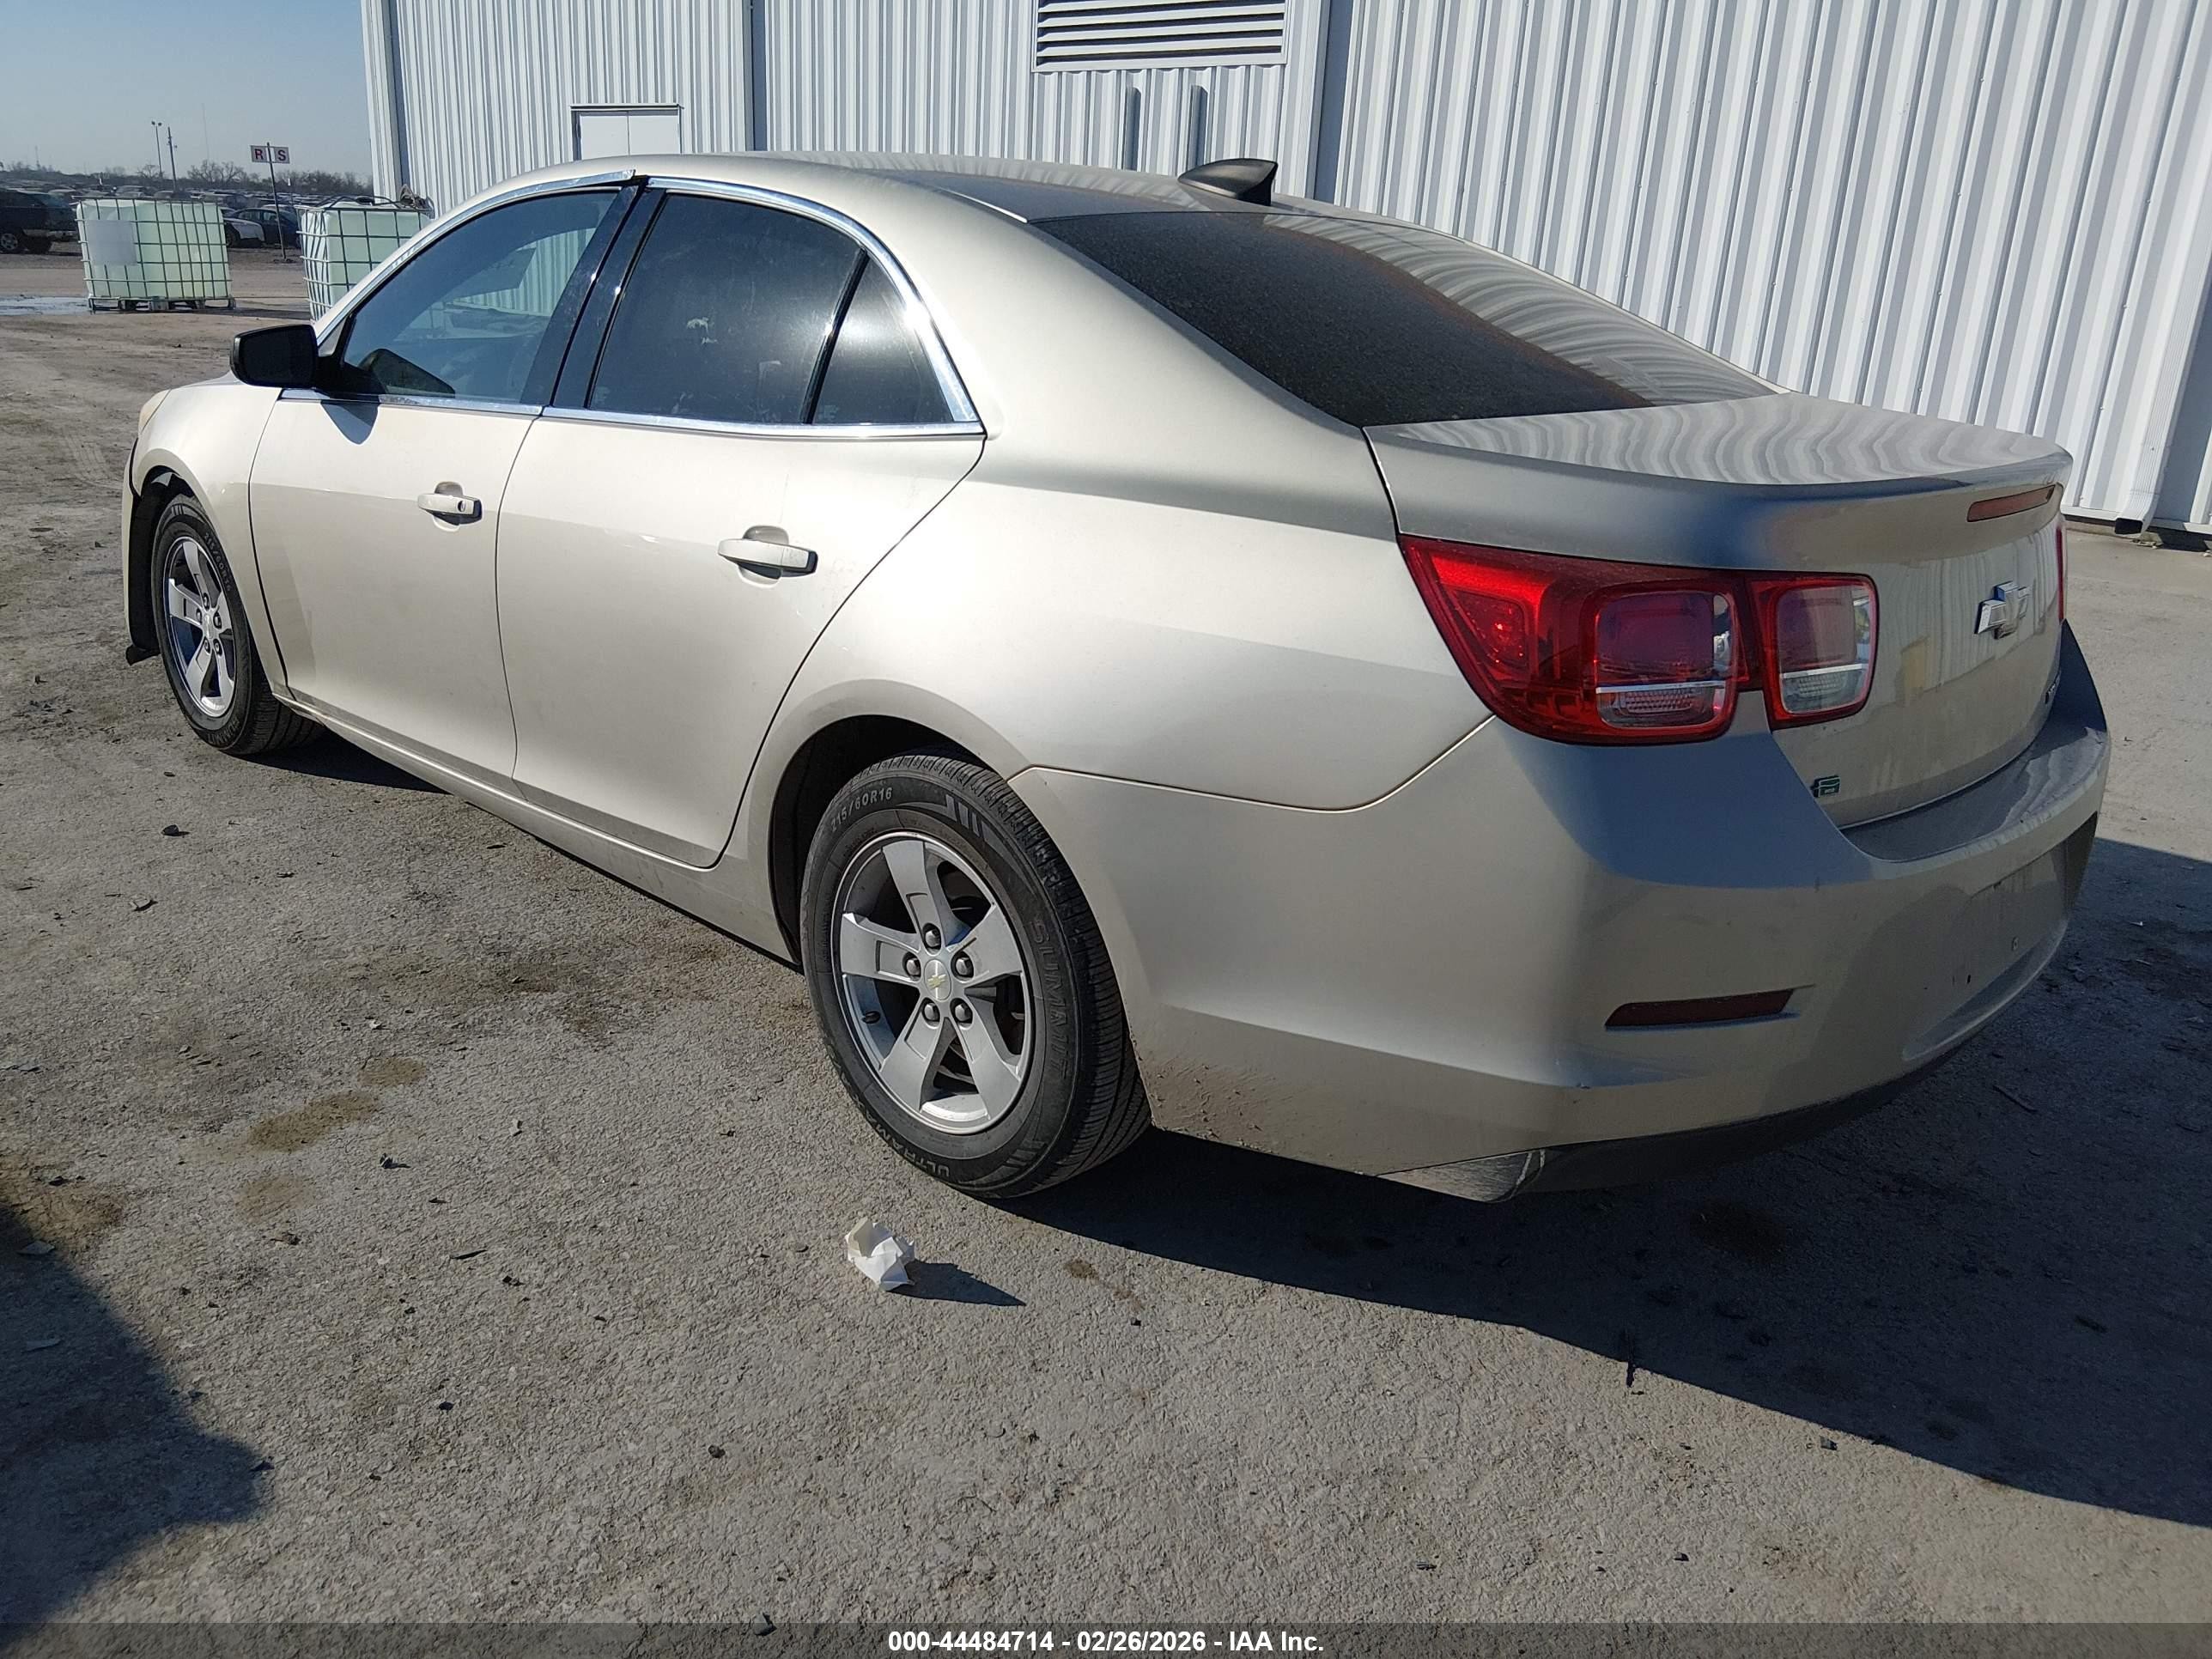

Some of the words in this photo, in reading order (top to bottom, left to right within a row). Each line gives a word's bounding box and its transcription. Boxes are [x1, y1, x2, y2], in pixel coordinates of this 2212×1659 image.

[254, 149, 264, 160] R
[277, 149, 287, 161] S
[830, 787, 893, 833] 215/60R16
[1030, 921, 1068, 1079] SUMMIT
